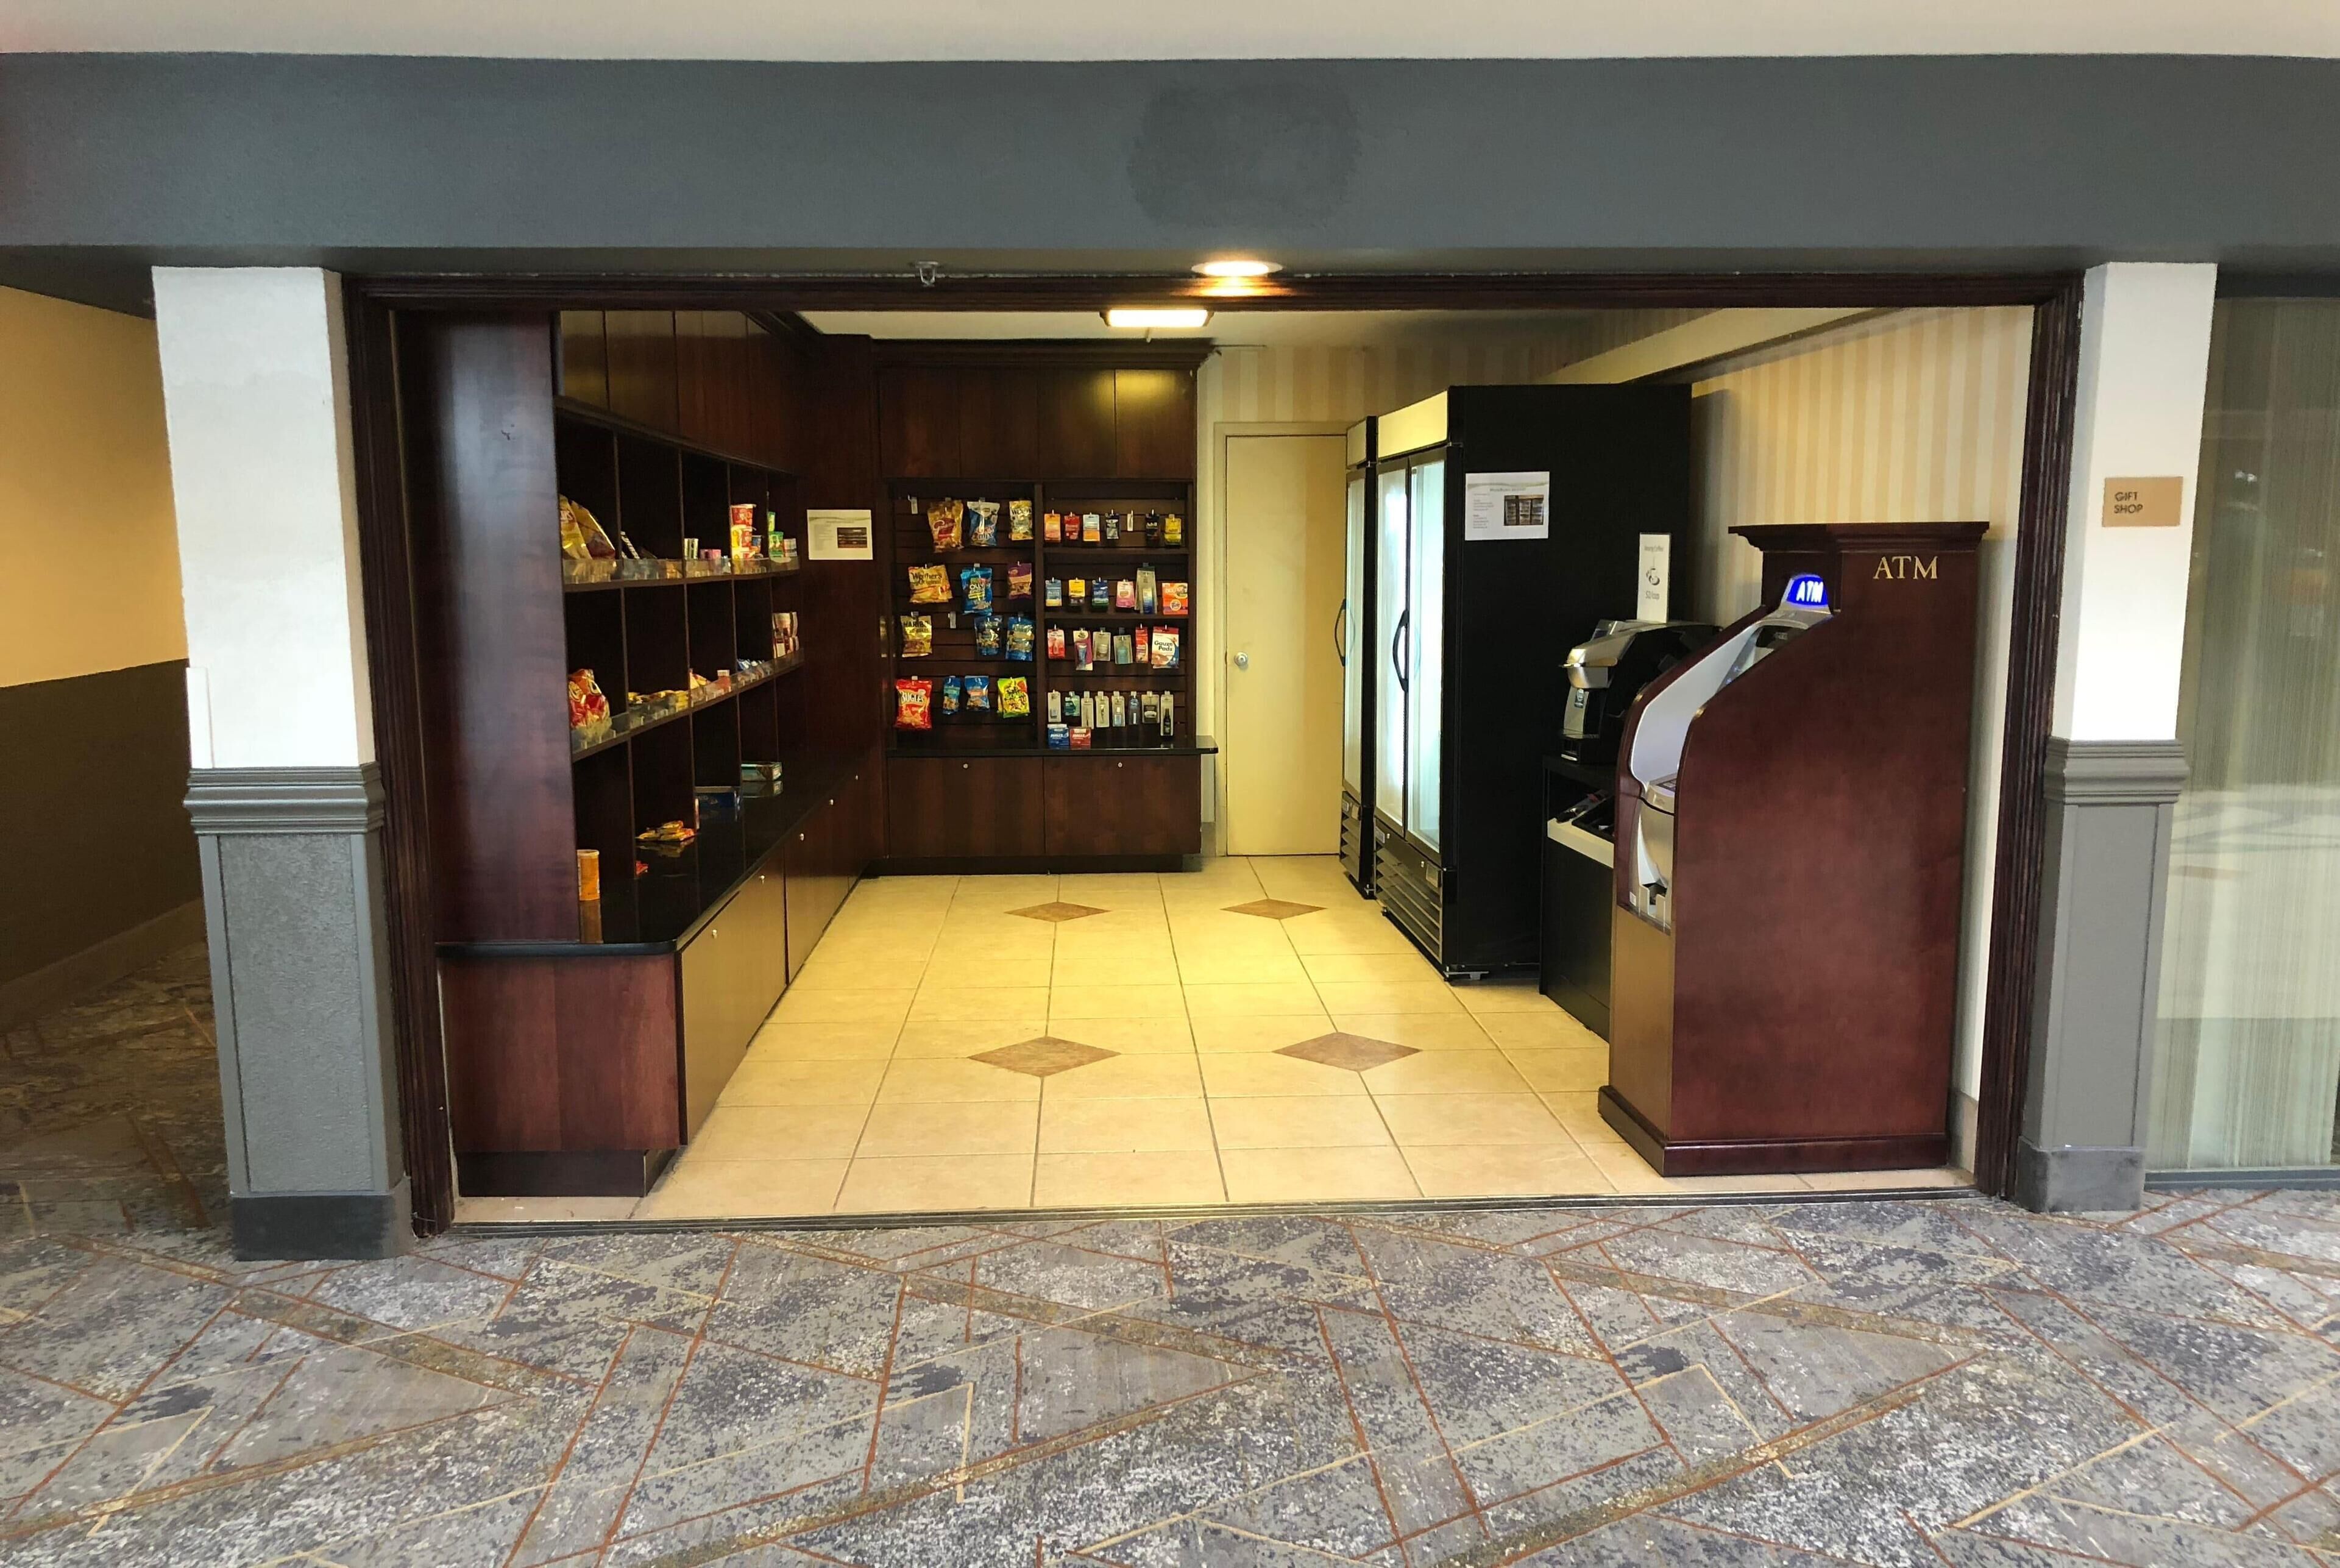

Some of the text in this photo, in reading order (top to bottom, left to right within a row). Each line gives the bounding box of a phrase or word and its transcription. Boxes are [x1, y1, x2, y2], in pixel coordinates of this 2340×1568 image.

[2115, 492, 2138, 502] GIFT
[2114, 504, 2143, 514] SHOP
[1873, 555, 1938, 580] ATM
[1796, 581, 1824, 603] ATM
[901, 690, 924, 703] BUGLES
